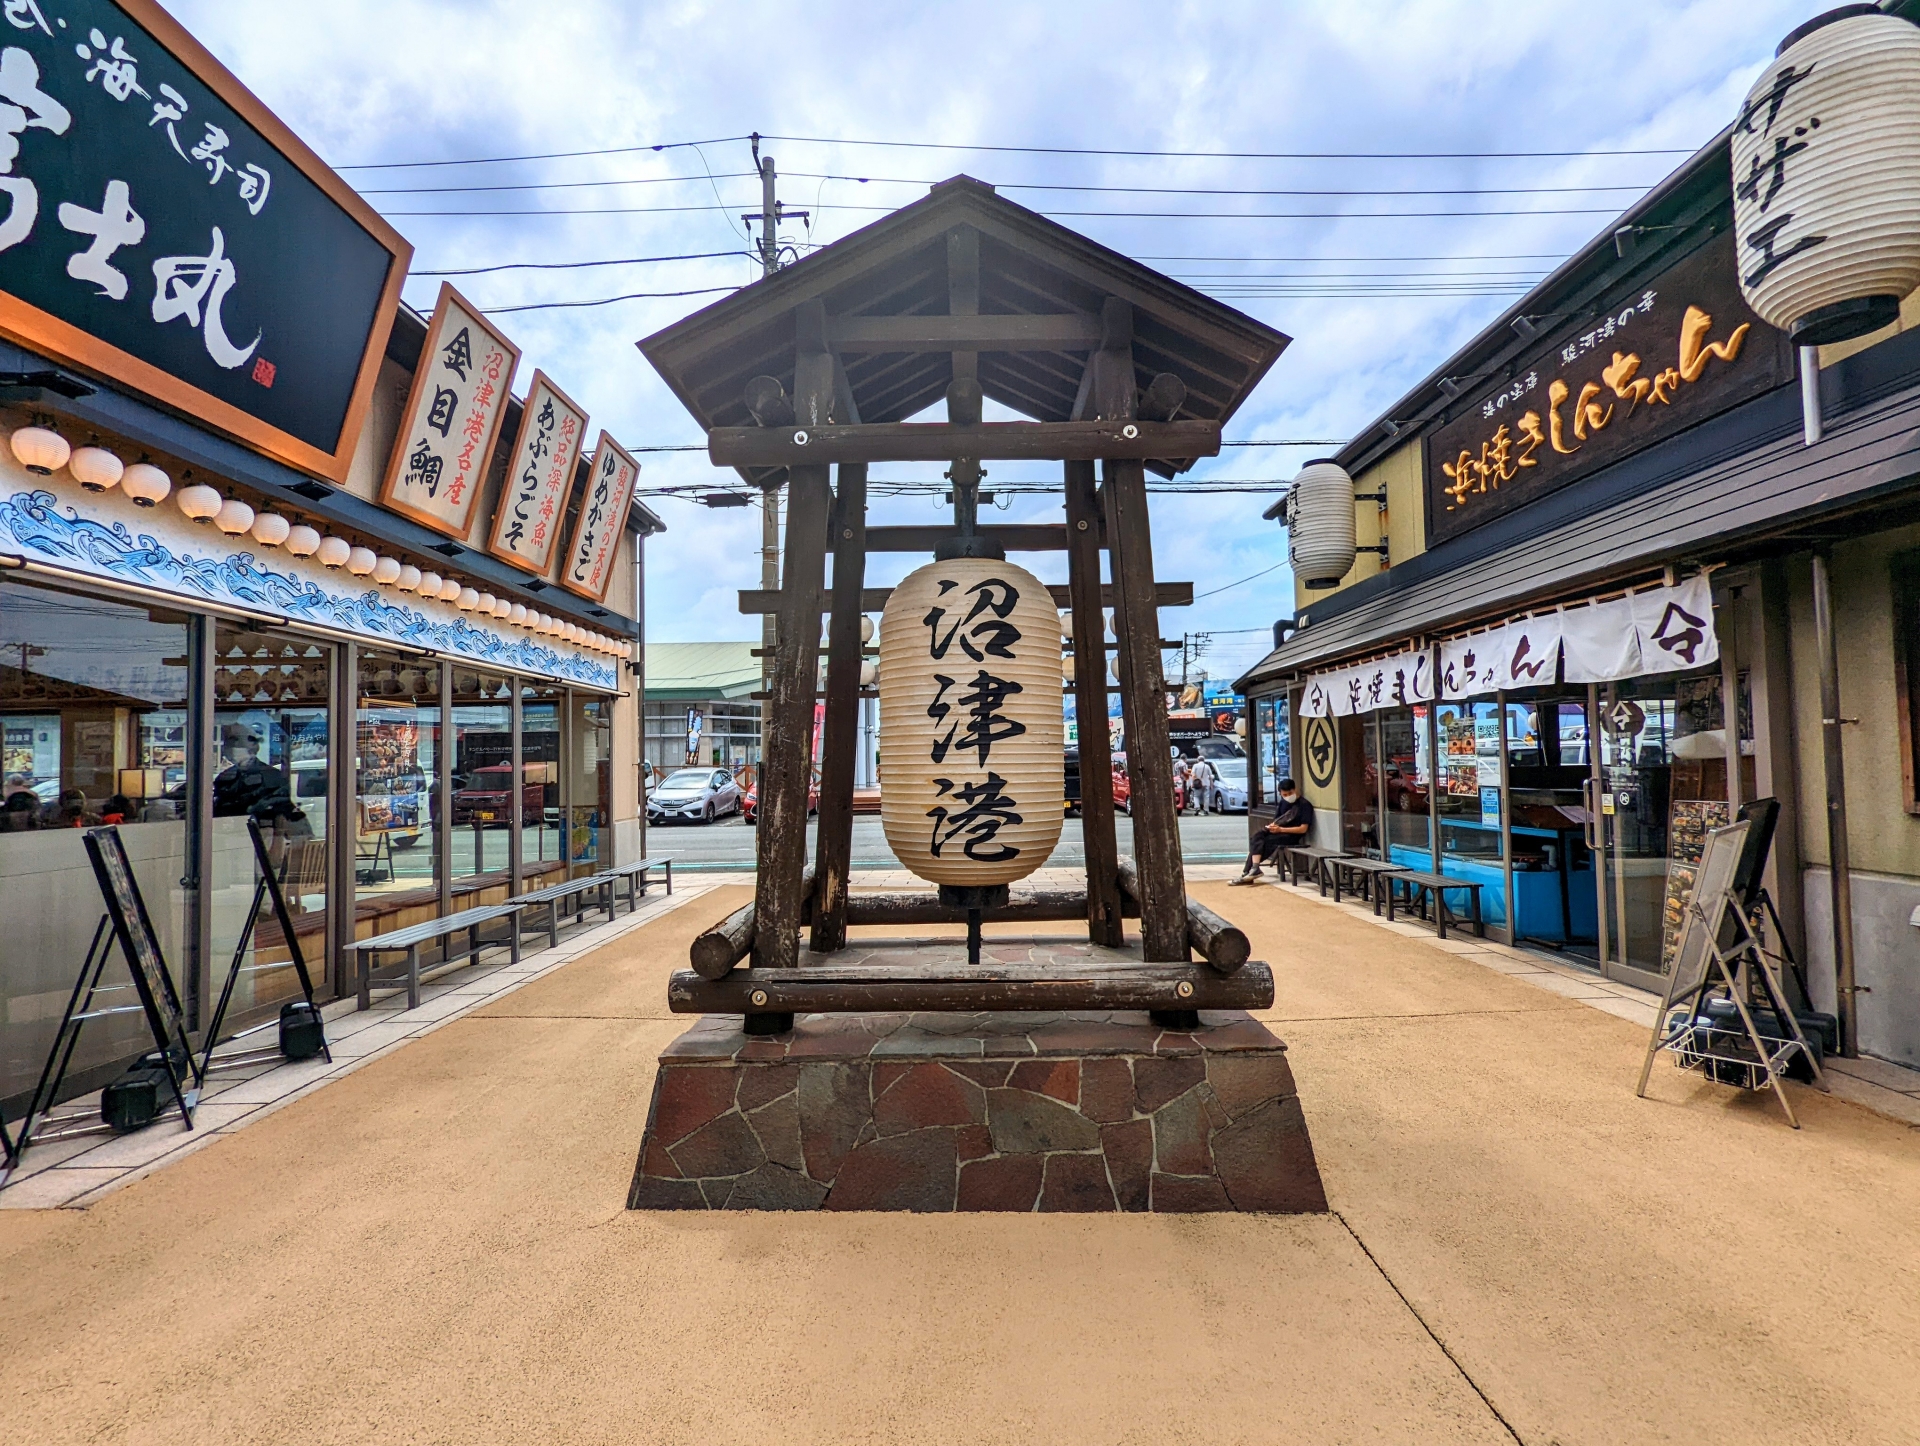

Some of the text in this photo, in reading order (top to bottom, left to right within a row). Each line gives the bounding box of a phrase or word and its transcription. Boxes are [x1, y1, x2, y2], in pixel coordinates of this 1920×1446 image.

[1561, 290, 1658, 366] 駿河湾の幸
[404, 326, 473, 498] 金目鯛
[442, 345, 504, 506] 沼津港名産
[504, 396, 555, 551] あぶらごそ
[530, 414, 577, 549] 絶品深海魚
[574, 452, 616, 582] ゆめかさご
[589, 465, 630, 590] 駿河湾の天使
[922, 577, 1026, 862] 沼津港
